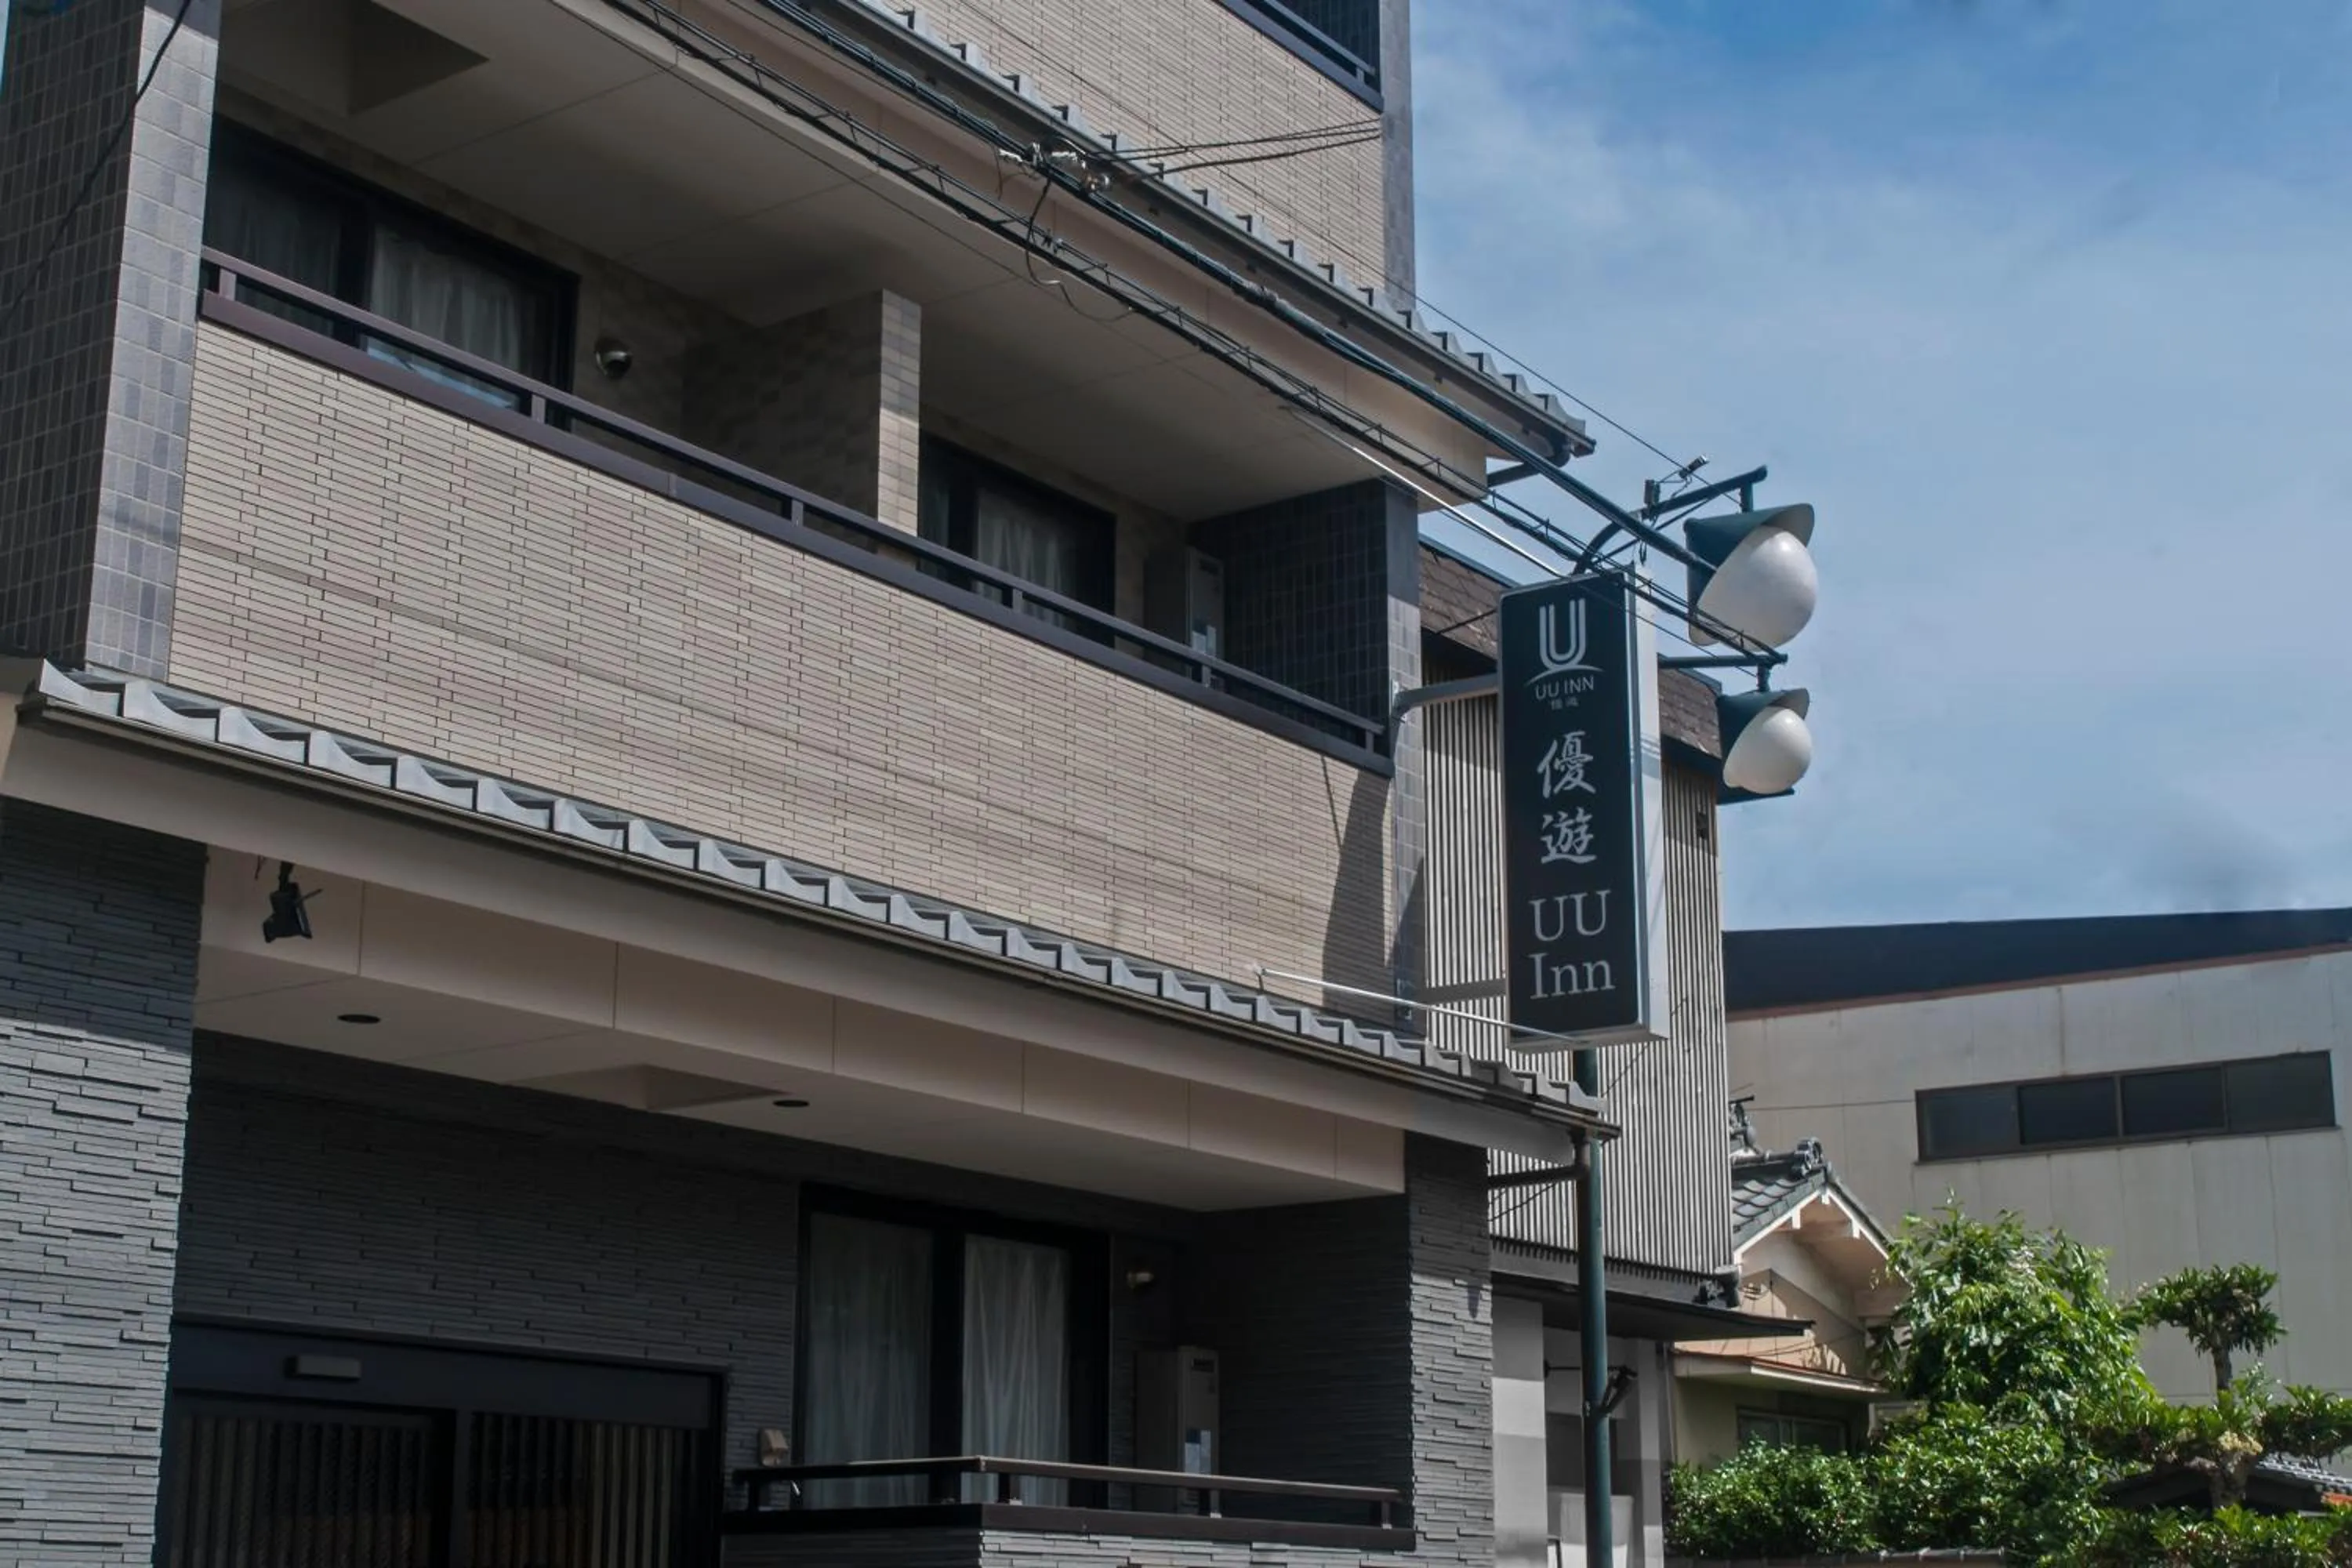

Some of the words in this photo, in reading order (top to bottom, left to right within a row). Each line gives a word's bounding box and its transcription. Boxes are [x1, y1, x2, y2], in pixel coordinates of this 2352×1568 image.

[1535, 681, 1559, 700] UU
[1564, 676, 1595, 694] INN
[1537, 730, 1597, 864] 優遊
[1529, 889, 1611, 942] UU
[1528, 953, 1616, 1000] Inn
